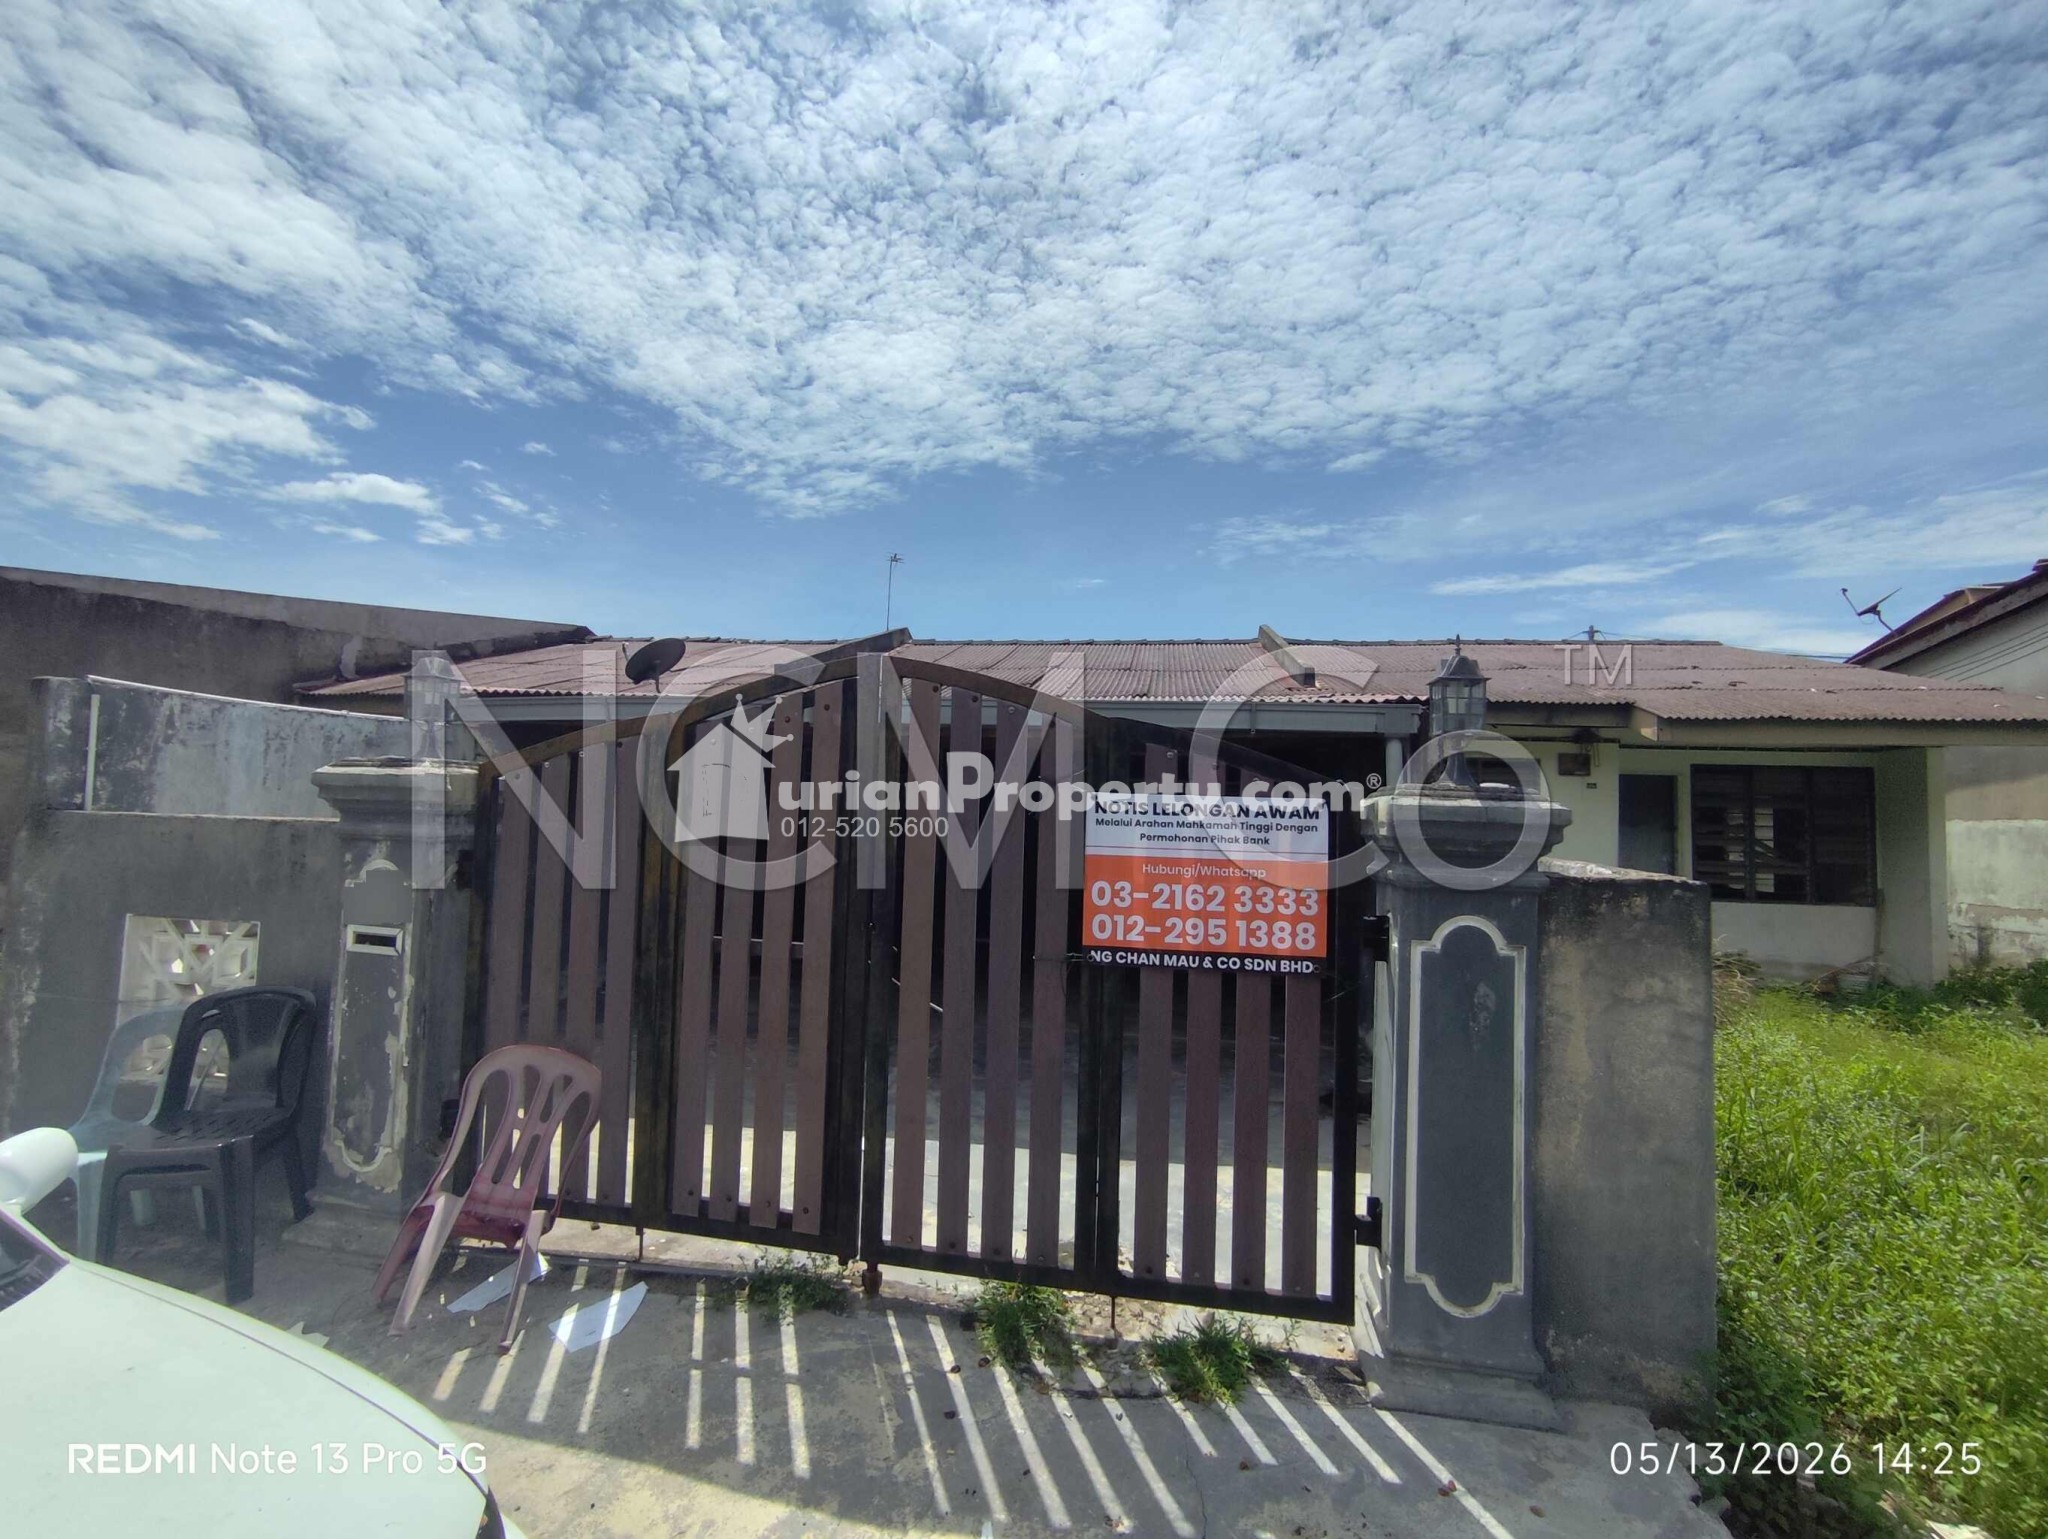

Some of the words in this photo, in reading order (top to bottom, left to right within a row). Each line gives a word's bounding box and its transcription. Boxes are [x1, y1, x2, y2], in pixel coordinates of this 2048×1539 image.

[1094, 800, 1149, 818] NOTIS
[1152, 802, 1250, 820] LELONGAN
[1253, 804, 1321, 820] AWAM
[1095, 817, 1133, 828] Melalui
[1134, 818, 1174, 829] Arahan
[1176, 819, 1238, 831] Mahkamah
[1239, 821, 1274, 834] Tinggi
[1275, 823, 1318, 835] Dengan
[1139, 832, 1209, 844] Permohonan
[1210, 834, 1241, 845] Pihak
[1243, 835, 1270, 846] Bank
[1142, 863, 1267, 880] Hubungi/Whatsapp
[1091, 880, 1226, 913] 03-2162
[1233, 885, 1319, 916] 3333
[1091, 914, 1228, 945] 012-295
[1235, 919, 1316, 951] 1388
[1090, 950, 1113, 964] NG
[1115, 951, 1161, 967] CHAN
[1163, 954, 1200, 968] MAU
[1202, 955, 1213, 969] &
[1216, 956, 1241, 971] CO
[1244, 957, 1277, 972] SDN
[1280, 959, 1314, 974] BHD
